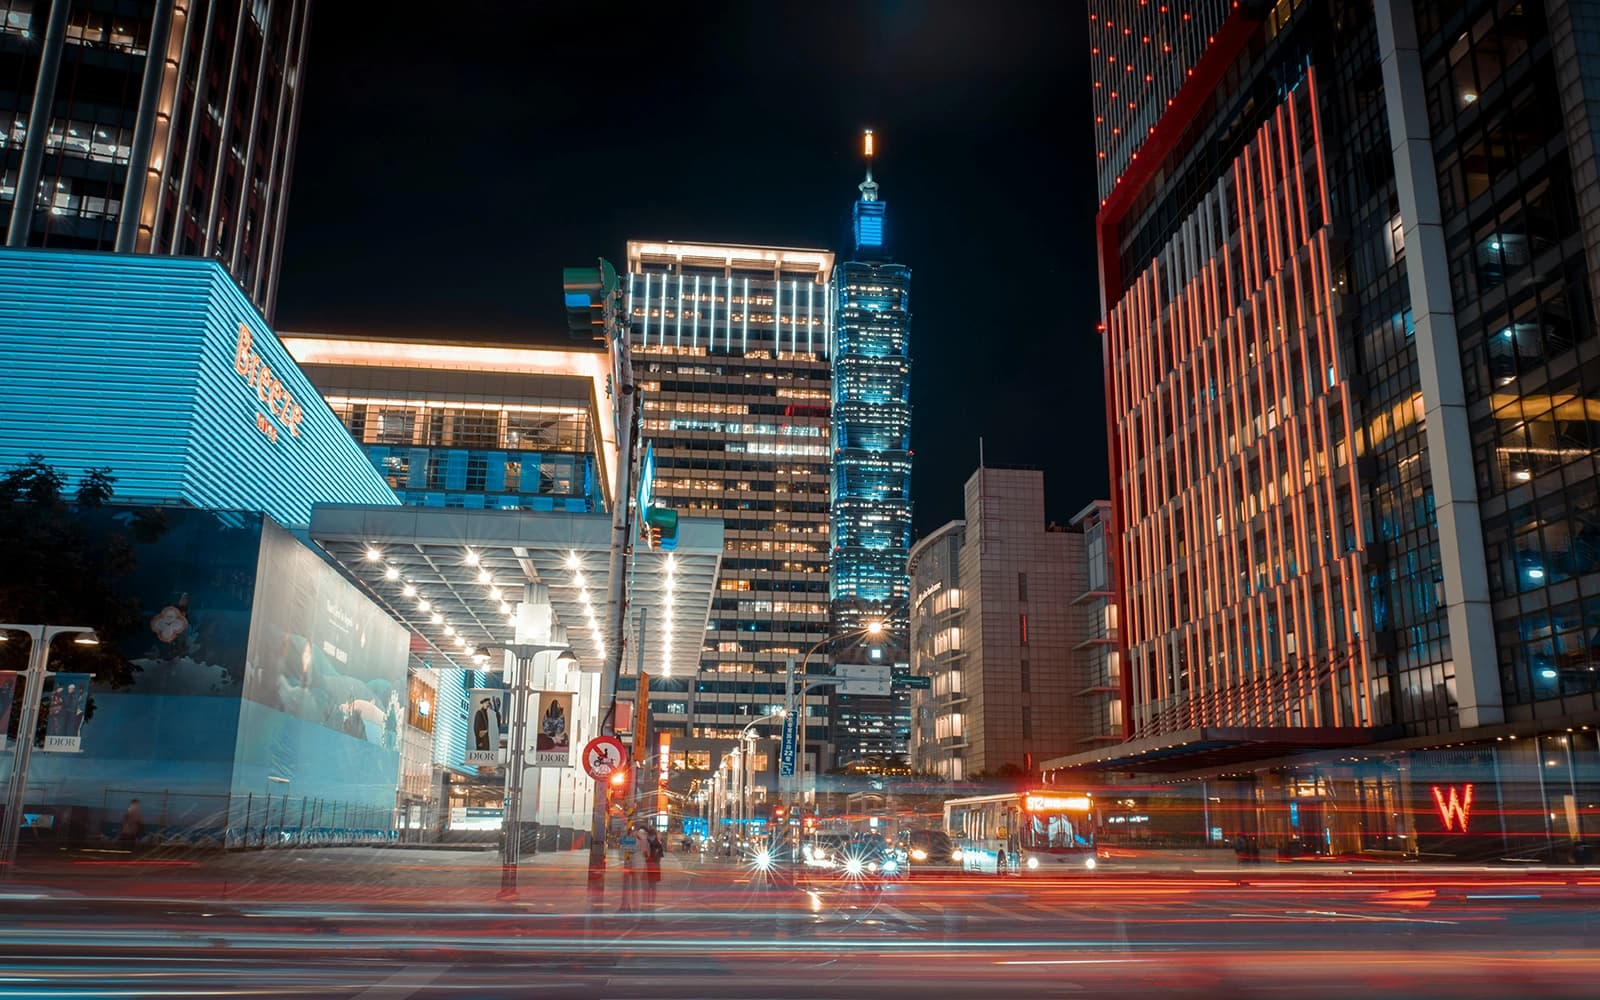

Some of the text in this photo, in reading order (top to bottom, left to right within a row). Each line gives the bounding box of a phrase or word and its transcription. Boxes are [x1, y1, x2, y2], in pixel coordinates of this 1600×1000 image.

[234, 322, 303, 438] Breeze
[49, 737, 76, 746] DIOR
[469, 751, 495, 761] DIOR
[540, 753, 566, 763] DIOR
[1432, 784, 1473, 833] W
